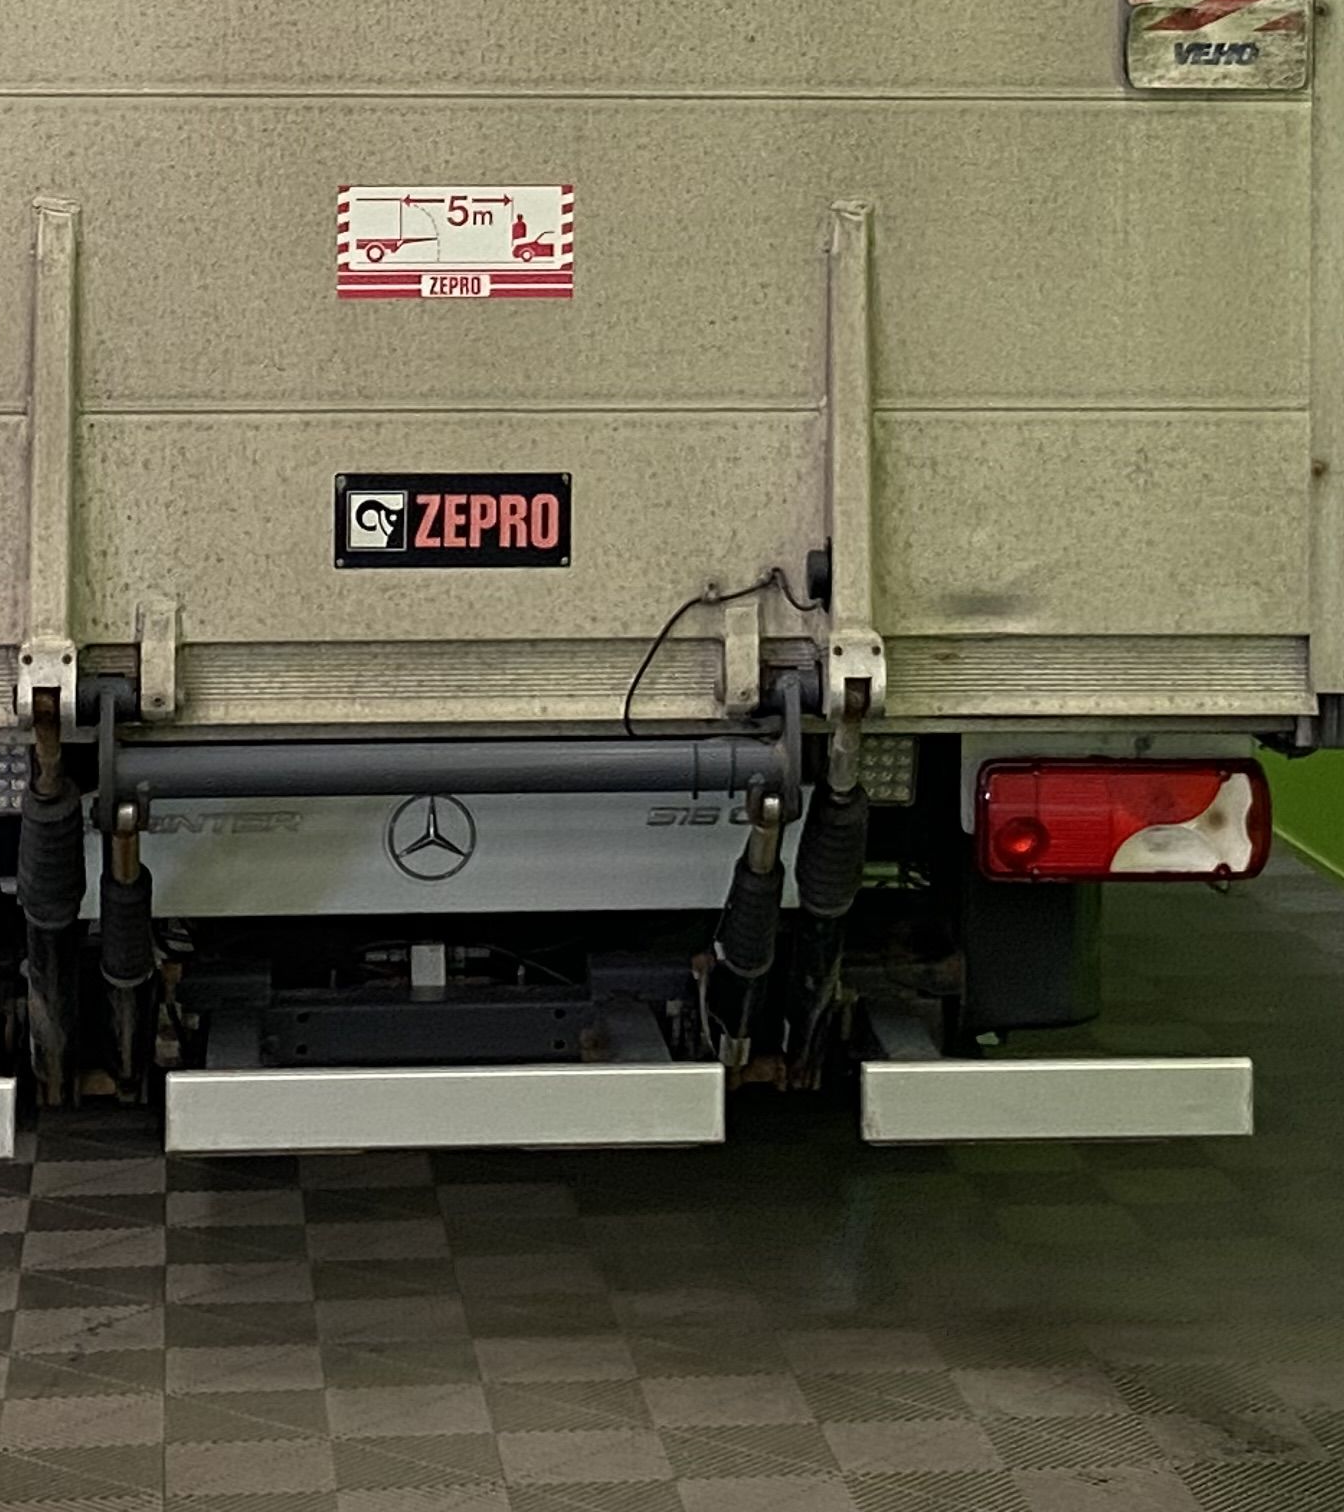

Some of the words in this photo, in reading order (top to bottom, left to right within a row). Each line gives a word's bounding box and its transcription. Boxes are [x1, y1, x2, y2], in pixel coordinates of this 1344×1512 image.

[1173, 41, 1260, 66] VEHO
[429, 276, 482, 296] ZEPRO
[414, 492, 560, 549] ZEPRO
